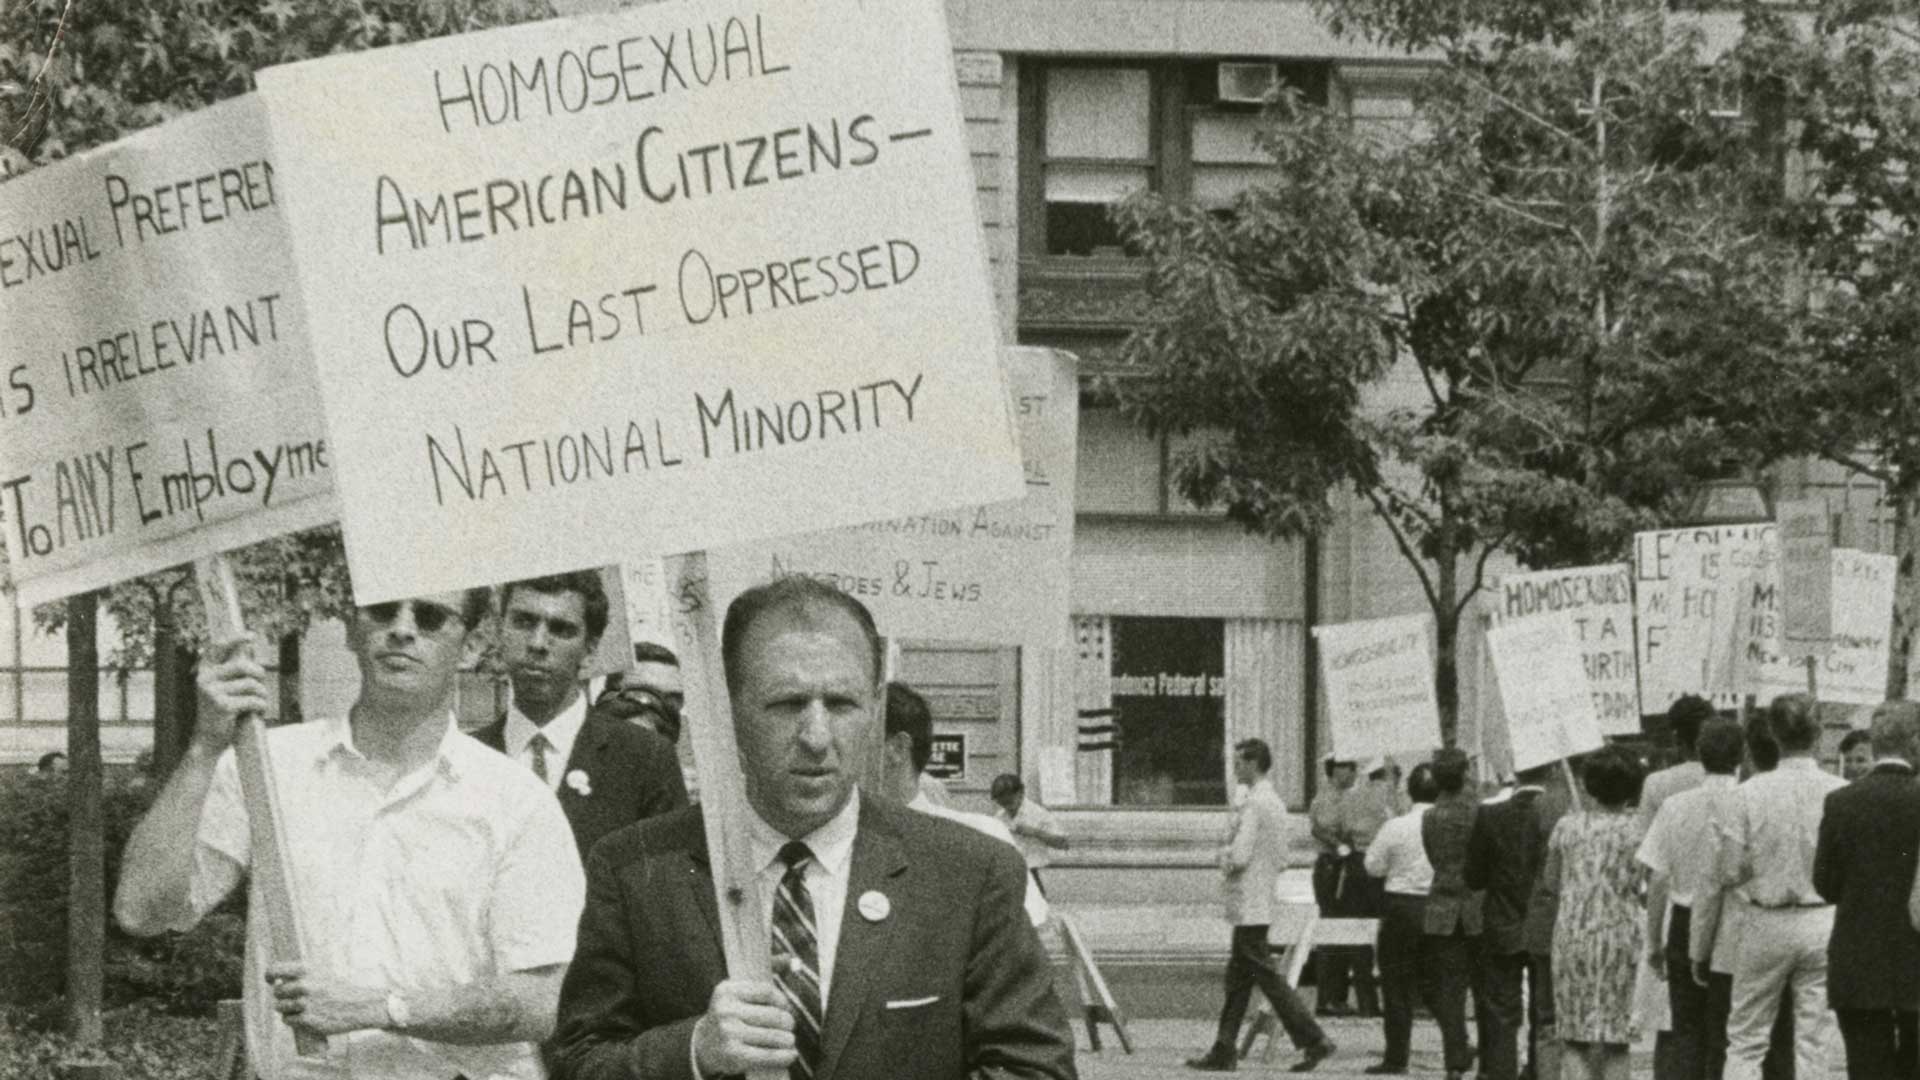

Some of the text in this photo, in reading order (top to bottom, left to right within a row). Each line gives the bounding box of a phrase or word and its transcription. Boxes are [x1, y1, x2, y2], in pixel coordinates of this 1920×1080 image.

[434, 14, 790, 132] HOMOSEXUAL
[376, 162, 626, 255] AMERICAN
[63, 294, 281, 398] IRRELEVANT
[384, 239, 920, 378] OUR LAST OPPRESSED
[426, 373, 922, 506] NATIONAL MINORITY
[56, 445, 114, 547] ANY
[972, 506, 1055, 541] AGAINST
[892, 559, 910, 596] &
[919, 561, 982, 602] JEWS
[1601, 617, 1618, 641] A
[1158, 672, 1206, 696] Federal
